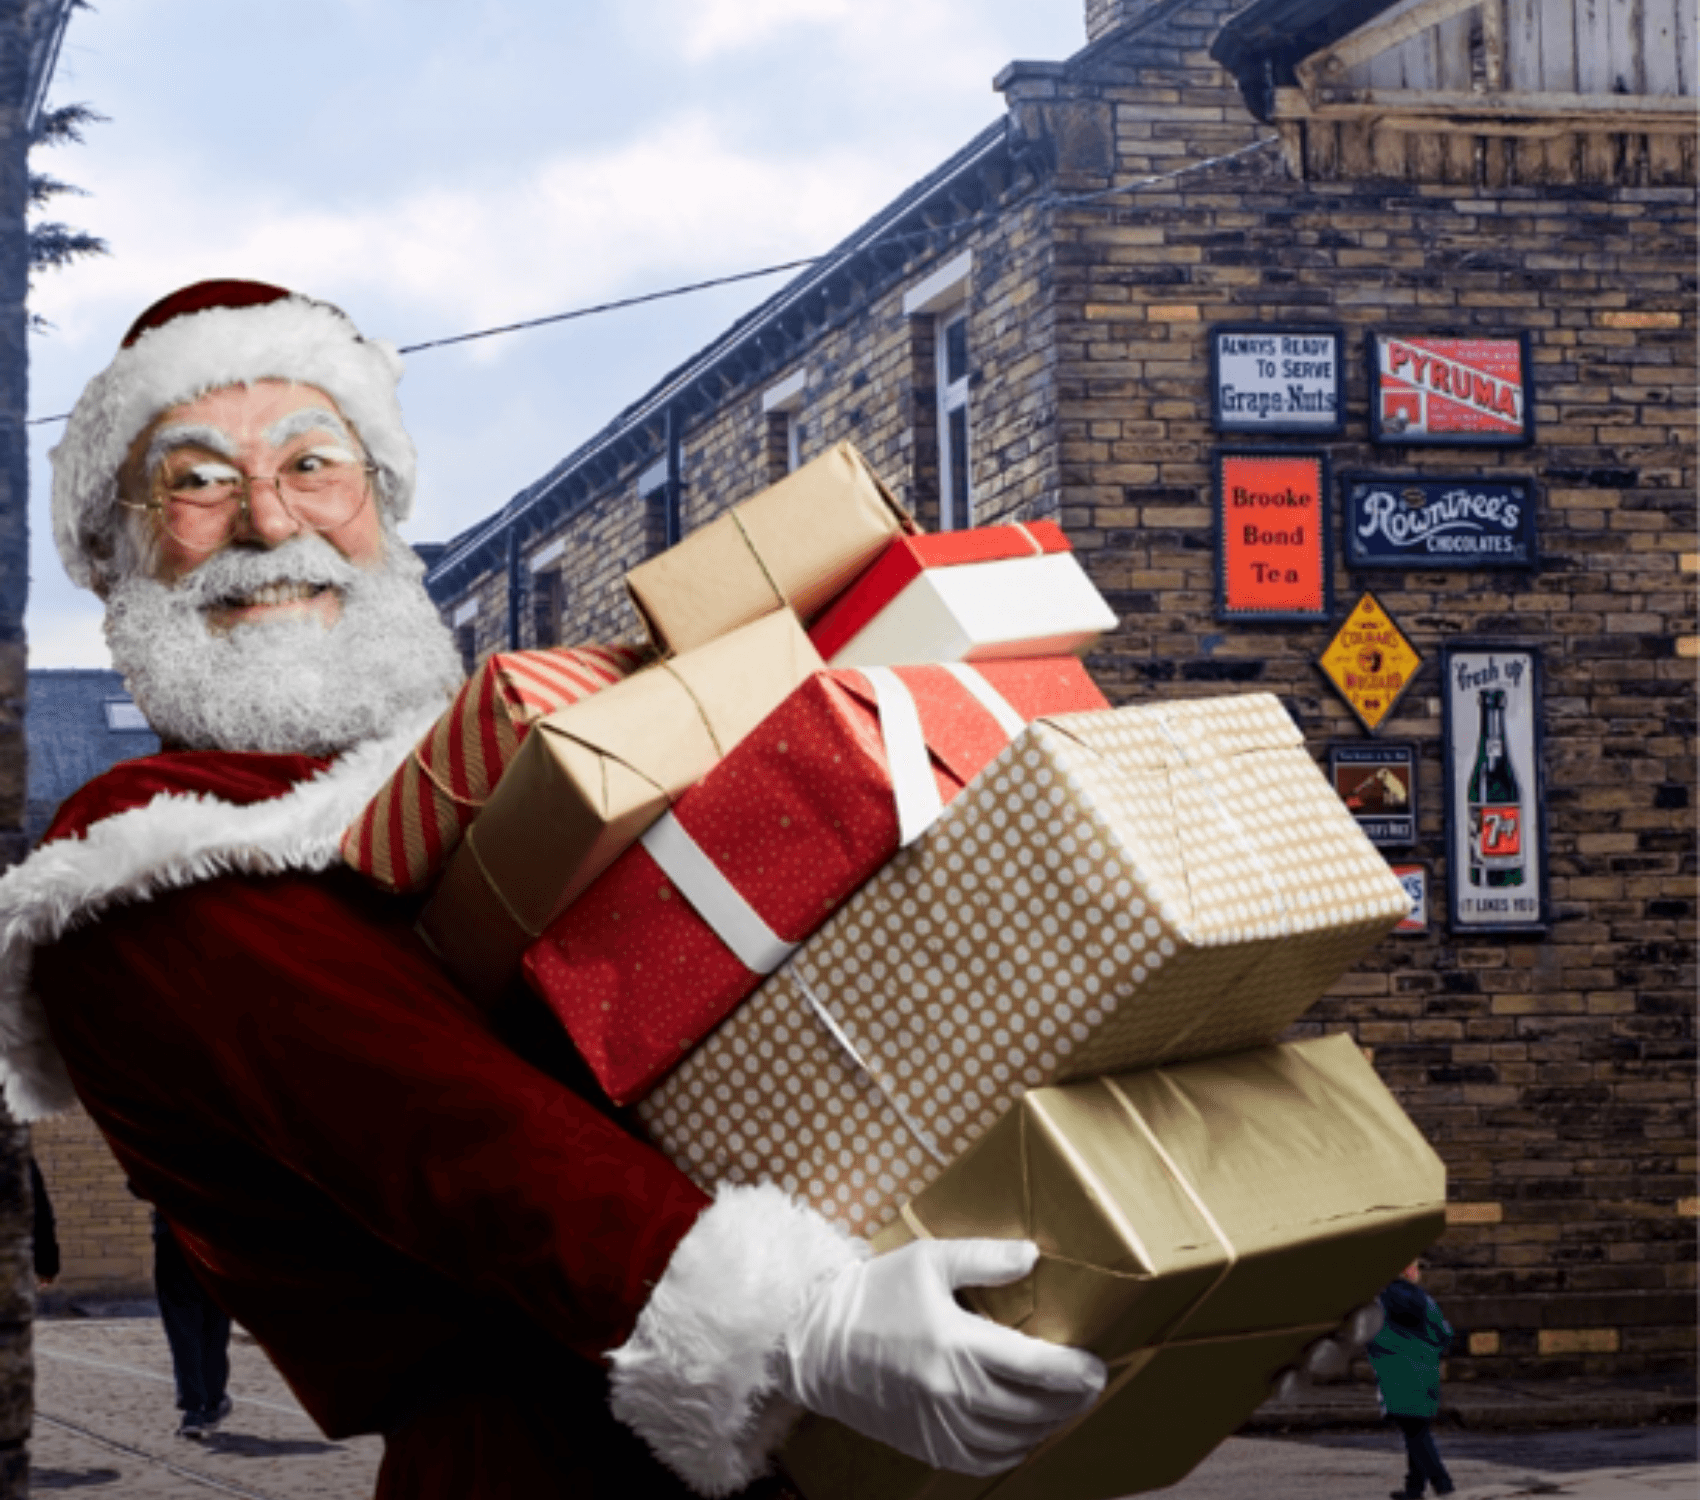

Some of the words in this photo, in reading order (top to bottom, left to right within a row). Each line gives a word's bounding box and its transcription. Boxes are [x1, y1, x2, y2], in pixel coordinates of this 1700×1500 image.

[1281, 337, 1328, 355] READY
[1256, 359, 1276, 378] TO
[1281, 359, 1331, 378] SERVE
[1389, 341, 1516, 418] PYRUMA
[1221, 384, 1337, 418] Grape-Nuts
[1231, 486, 1311, 508] Brooke
[1358, 489, 1519, 546] Rowntree's
[1243, 525, 1304, 545] Bond
[1427, 535, 1513, 552] CHOCOLATES
[1250, 563, 1299, 583] Tea
